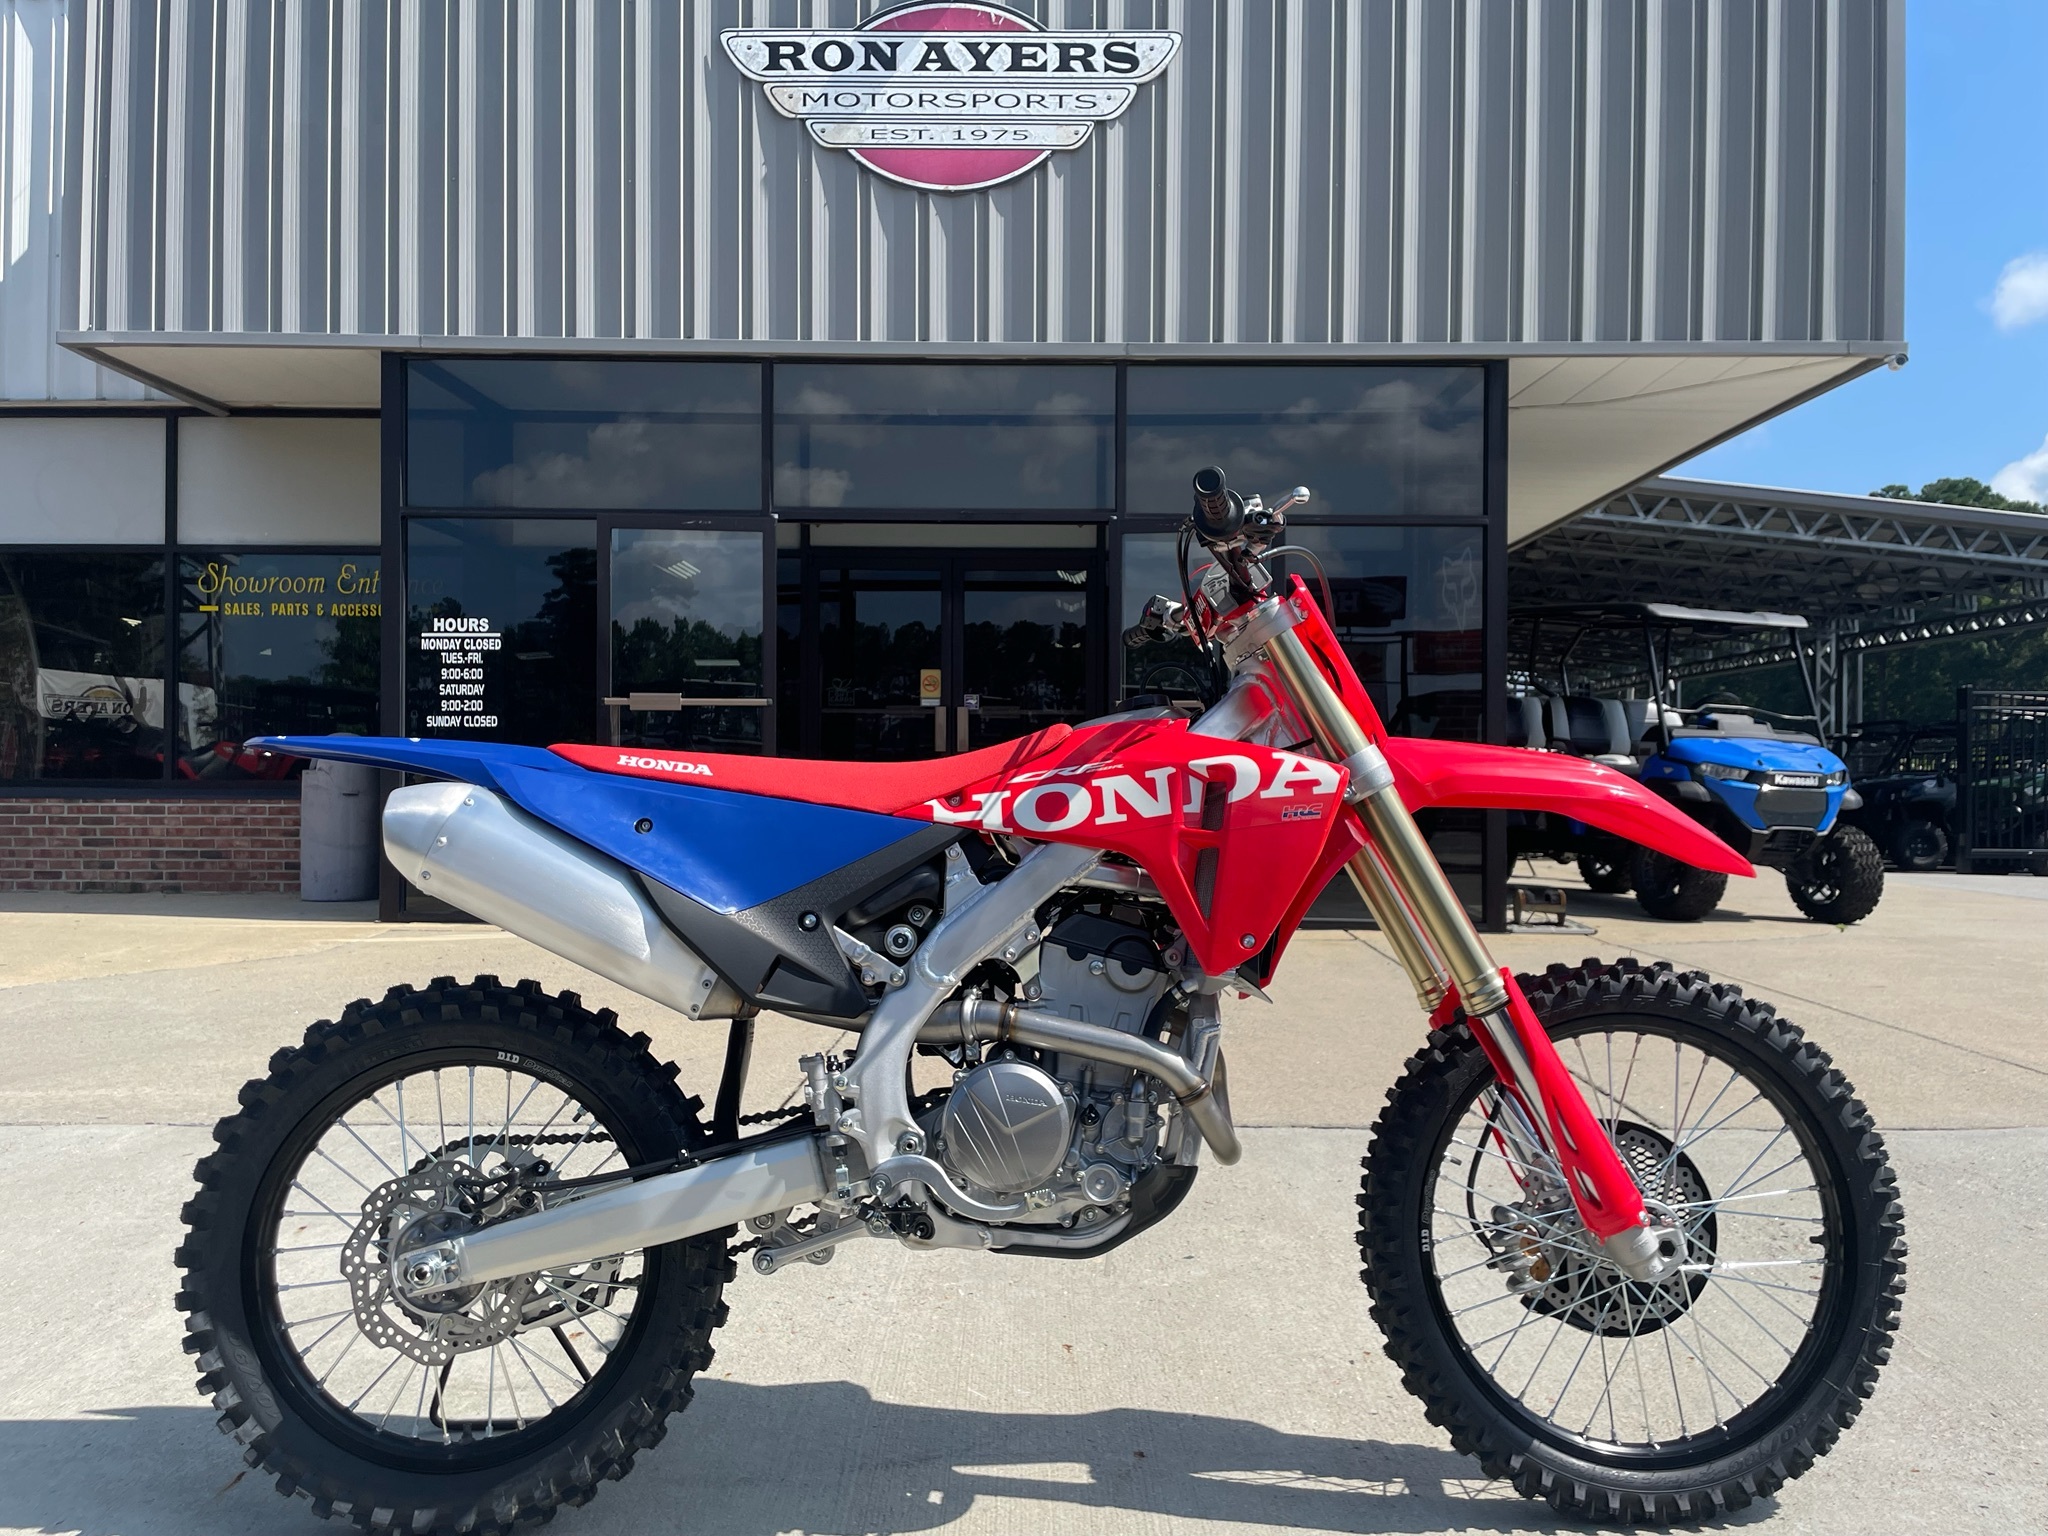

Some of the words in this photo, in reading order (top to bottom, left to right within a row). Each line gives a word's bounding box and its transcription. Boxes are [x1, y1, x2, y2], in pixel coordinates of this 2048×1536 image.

[762, 40, 910, 72] RON
[913, 40, 1140, 73] AYERS
[802, 92, 1097, 110] MOTORSPORTS
[870, 128, 935, 141] EST.
[953, 128, 1029, 142] 1975
[198, 562, 325, 597] Showroom
[224, 602, 265, 617] SALES,
[271, 603, 309, 616] PARTS
[316, 603, 324, 616] &
[433, 617, 490, 632] HOURS
[421, 638, 462, 650] MONDAY
[463, 638, 502, 650] CLOSED
[440, 652, 484, 664] TUES.-FRI.
[440, 667, 484, 680] 9:00-6:00
[439, 683, 485, 695] SATURDAY
[440, 699, 484, 711] 9:00-2:00
[426, 715, 462, 727] SUNDAY
[463, 715, 499, 727] CLOSED
[617, 754, 713, 776] HONDA
[1006, 759, 1114, 784] CRF
[1775, 774, 1819, 787] Kawasaki
[929, 752, 1340, 834] HONDA
[1282, 803, 1323, 819] HRC
[1005, 1093, 1048, 1108] HONDA
